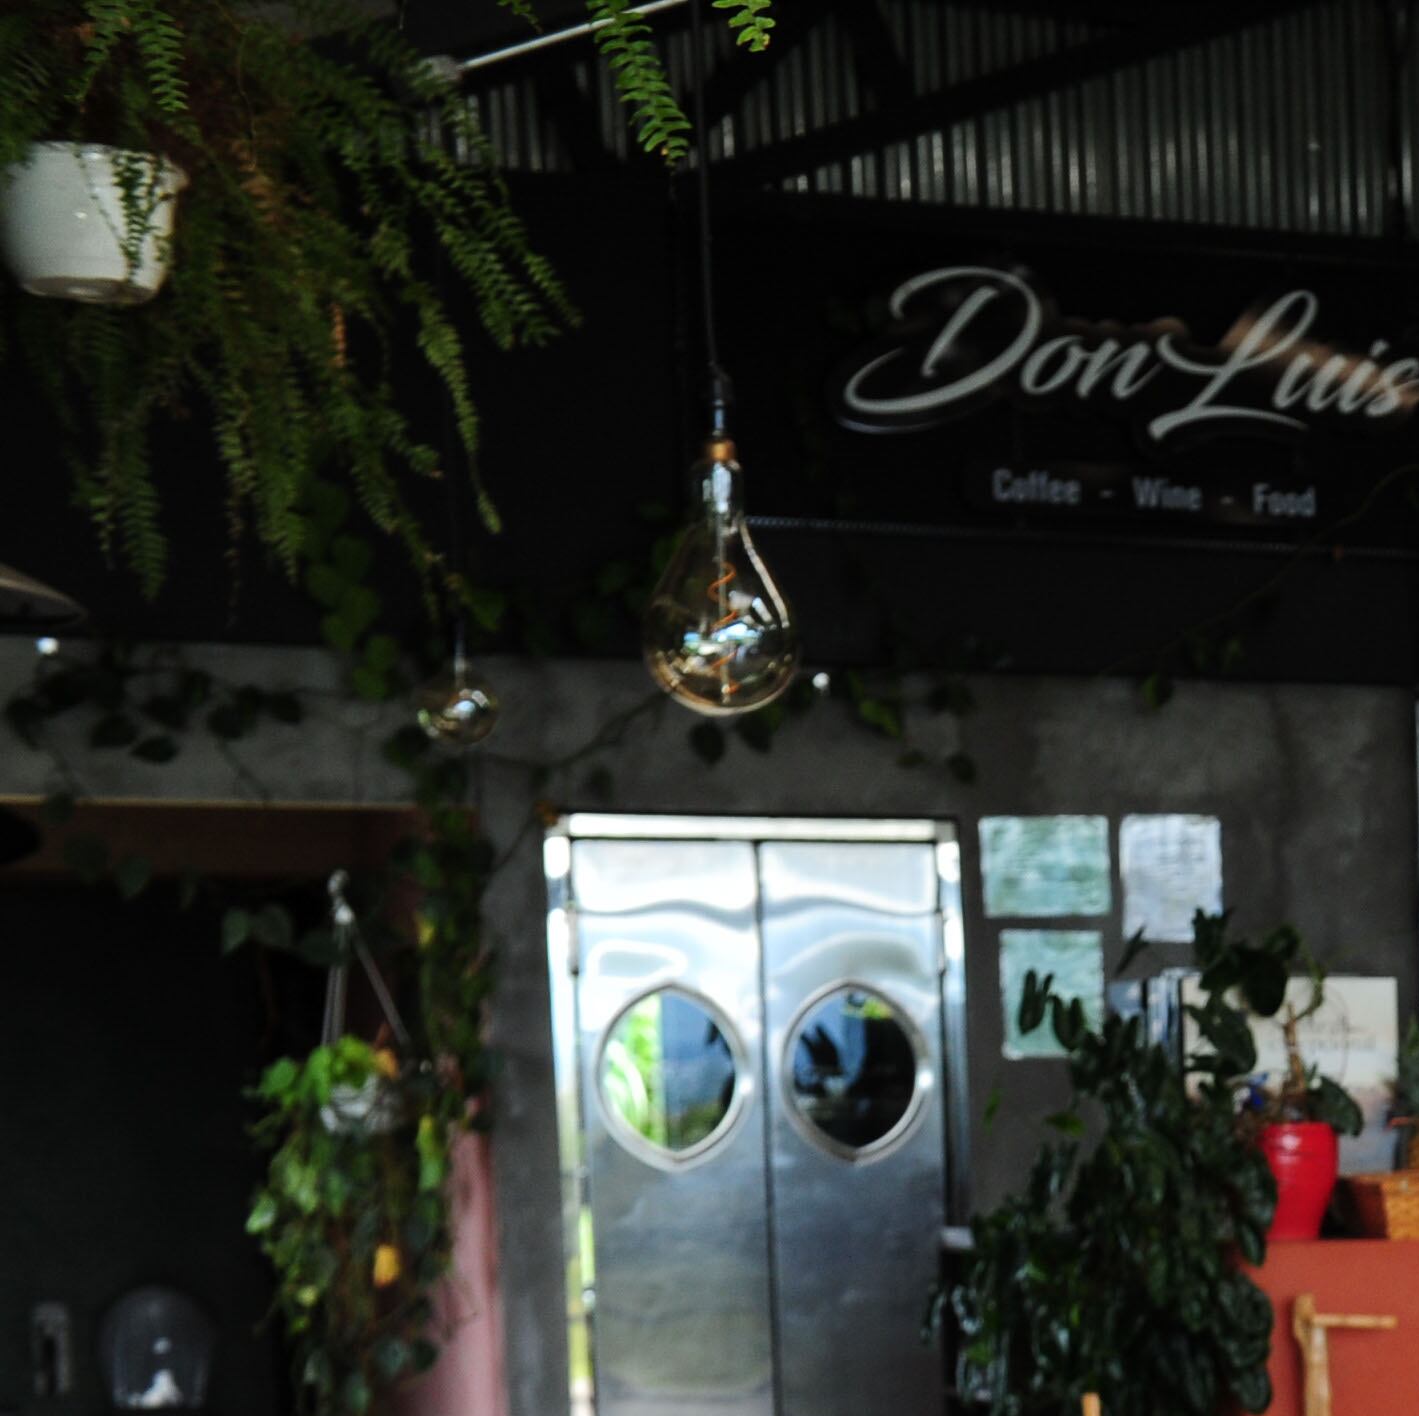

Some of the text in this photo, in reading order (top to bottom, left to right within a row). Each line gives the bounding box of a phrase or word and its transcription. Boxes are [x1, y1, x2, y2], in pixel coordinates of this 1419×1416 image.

[843, 266, 1164, 413] Don
[992, 468, 1081, 503] Coffee
[1133, 476, 1202, 511] Wine
[1253, 483, 1316, 517] Food
